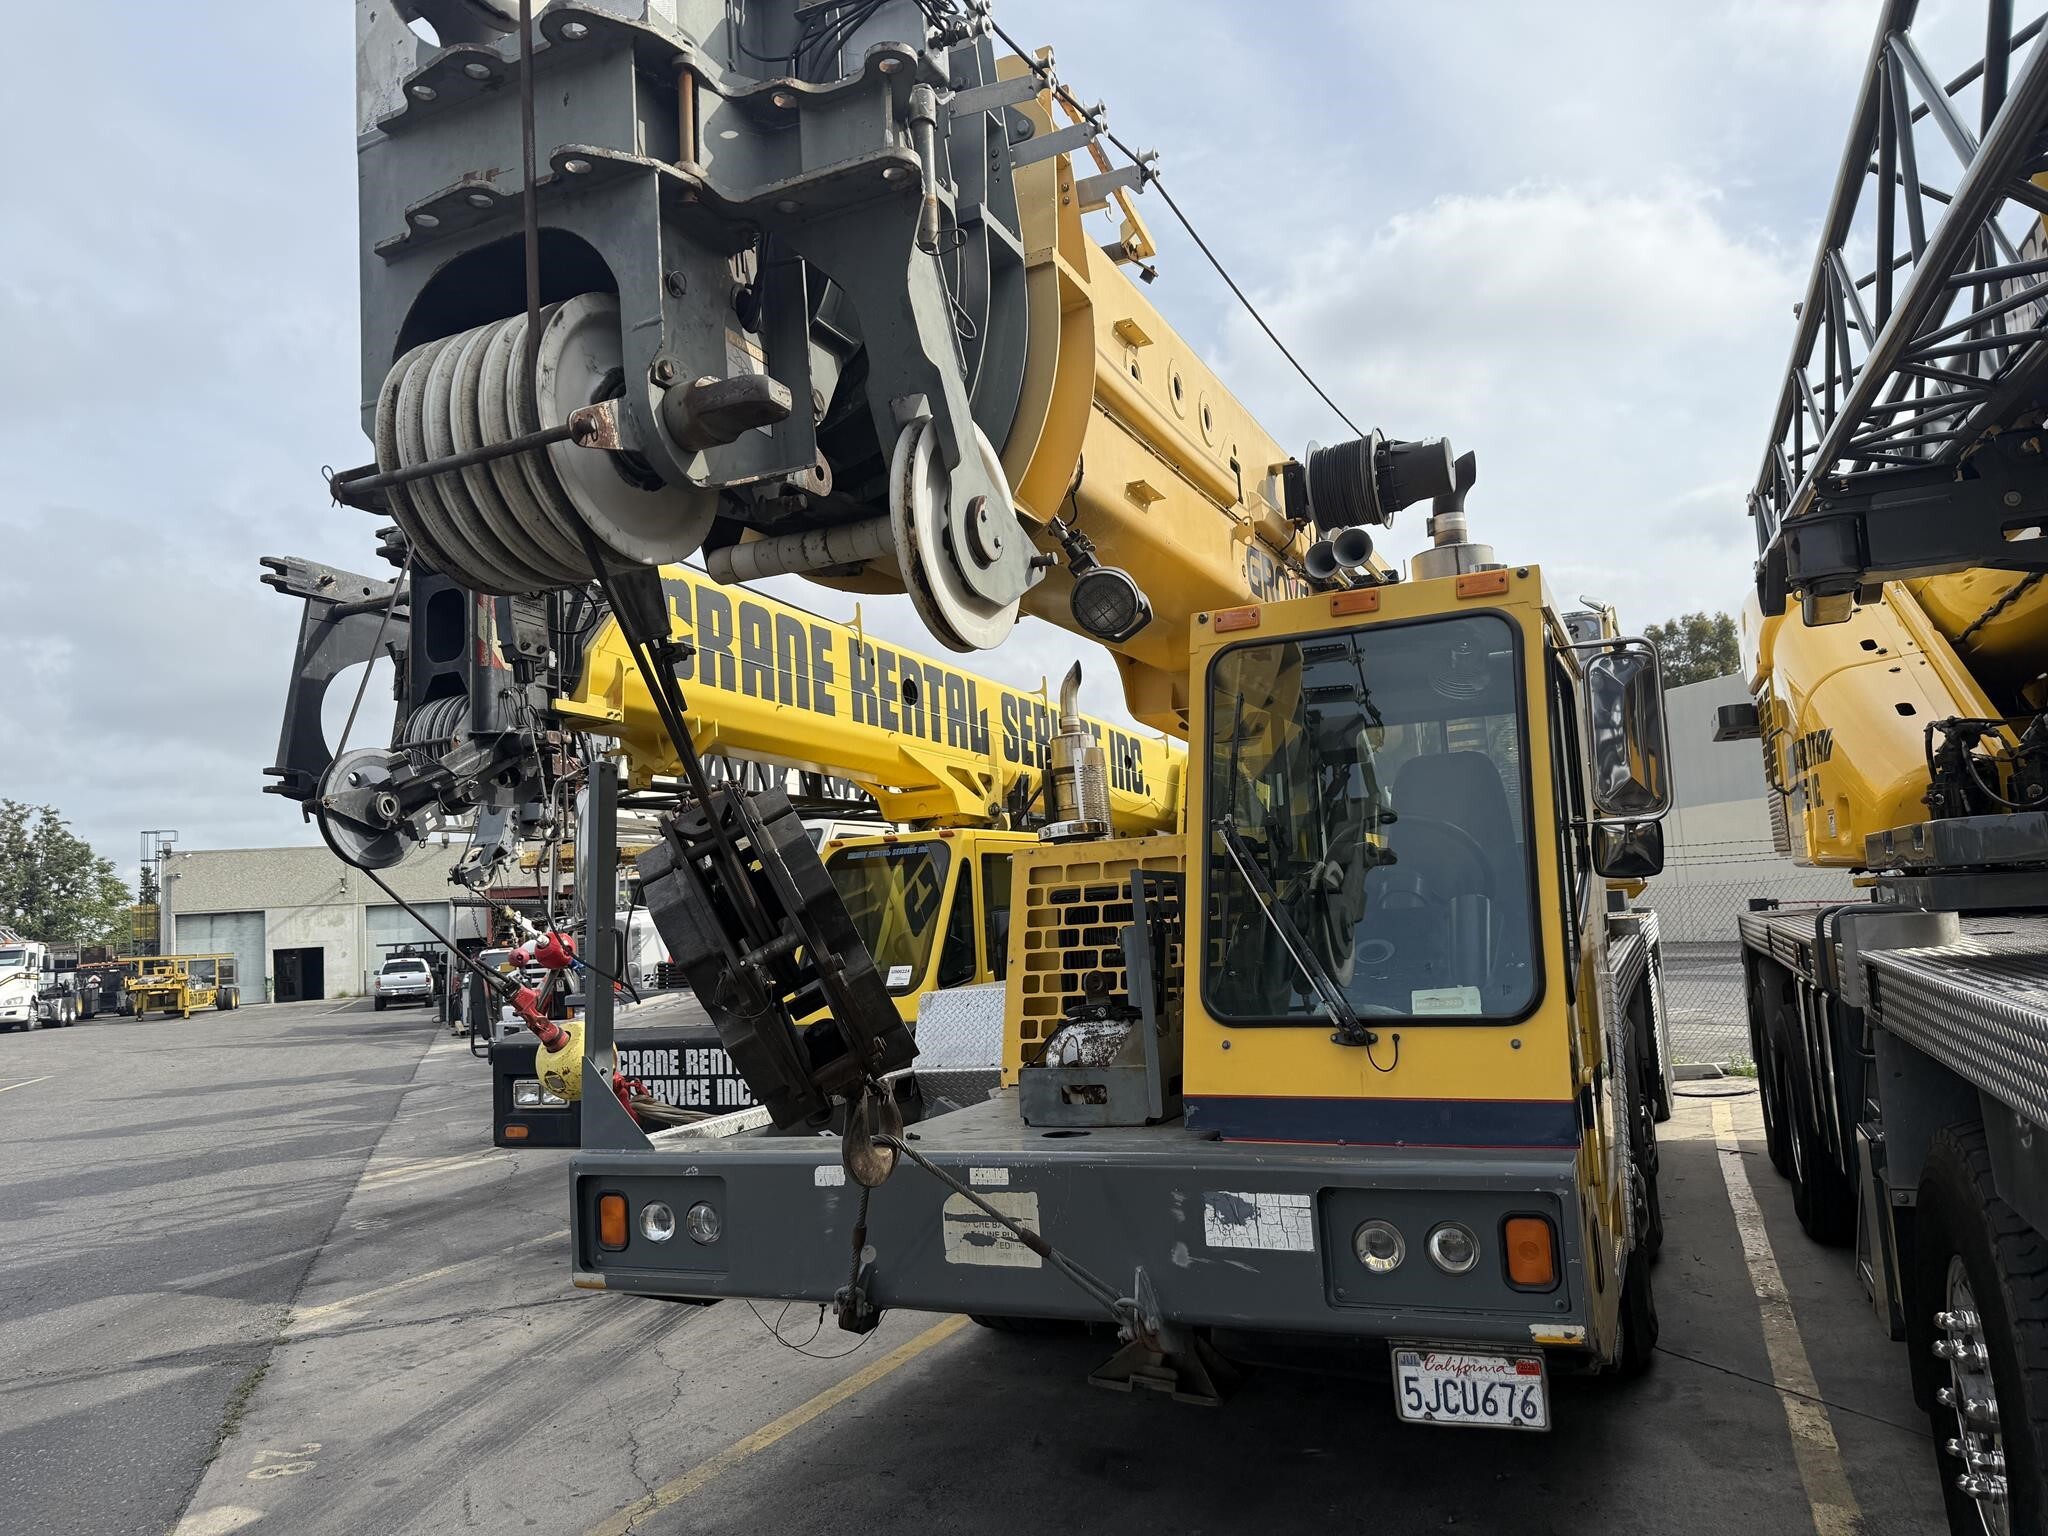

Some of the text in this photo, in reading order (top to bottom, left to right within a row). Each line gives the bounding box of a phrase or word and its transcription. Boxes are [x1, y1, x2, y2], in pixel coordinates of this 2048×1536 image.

[1247, 547, 1309, 602] GROV
[661, 577, 836, 717] CRANE
[850, 637, 990, 757] RENTAL
[1108, 728, 1151, 797] INC.
[617, 1048, 741, 1076] CRANE RENT
[716, 1079, 759, 1106] INC.
[1424, 1353, 1516, 1378] California
[1404, 1376, 1538, 1420] 5JCU676
